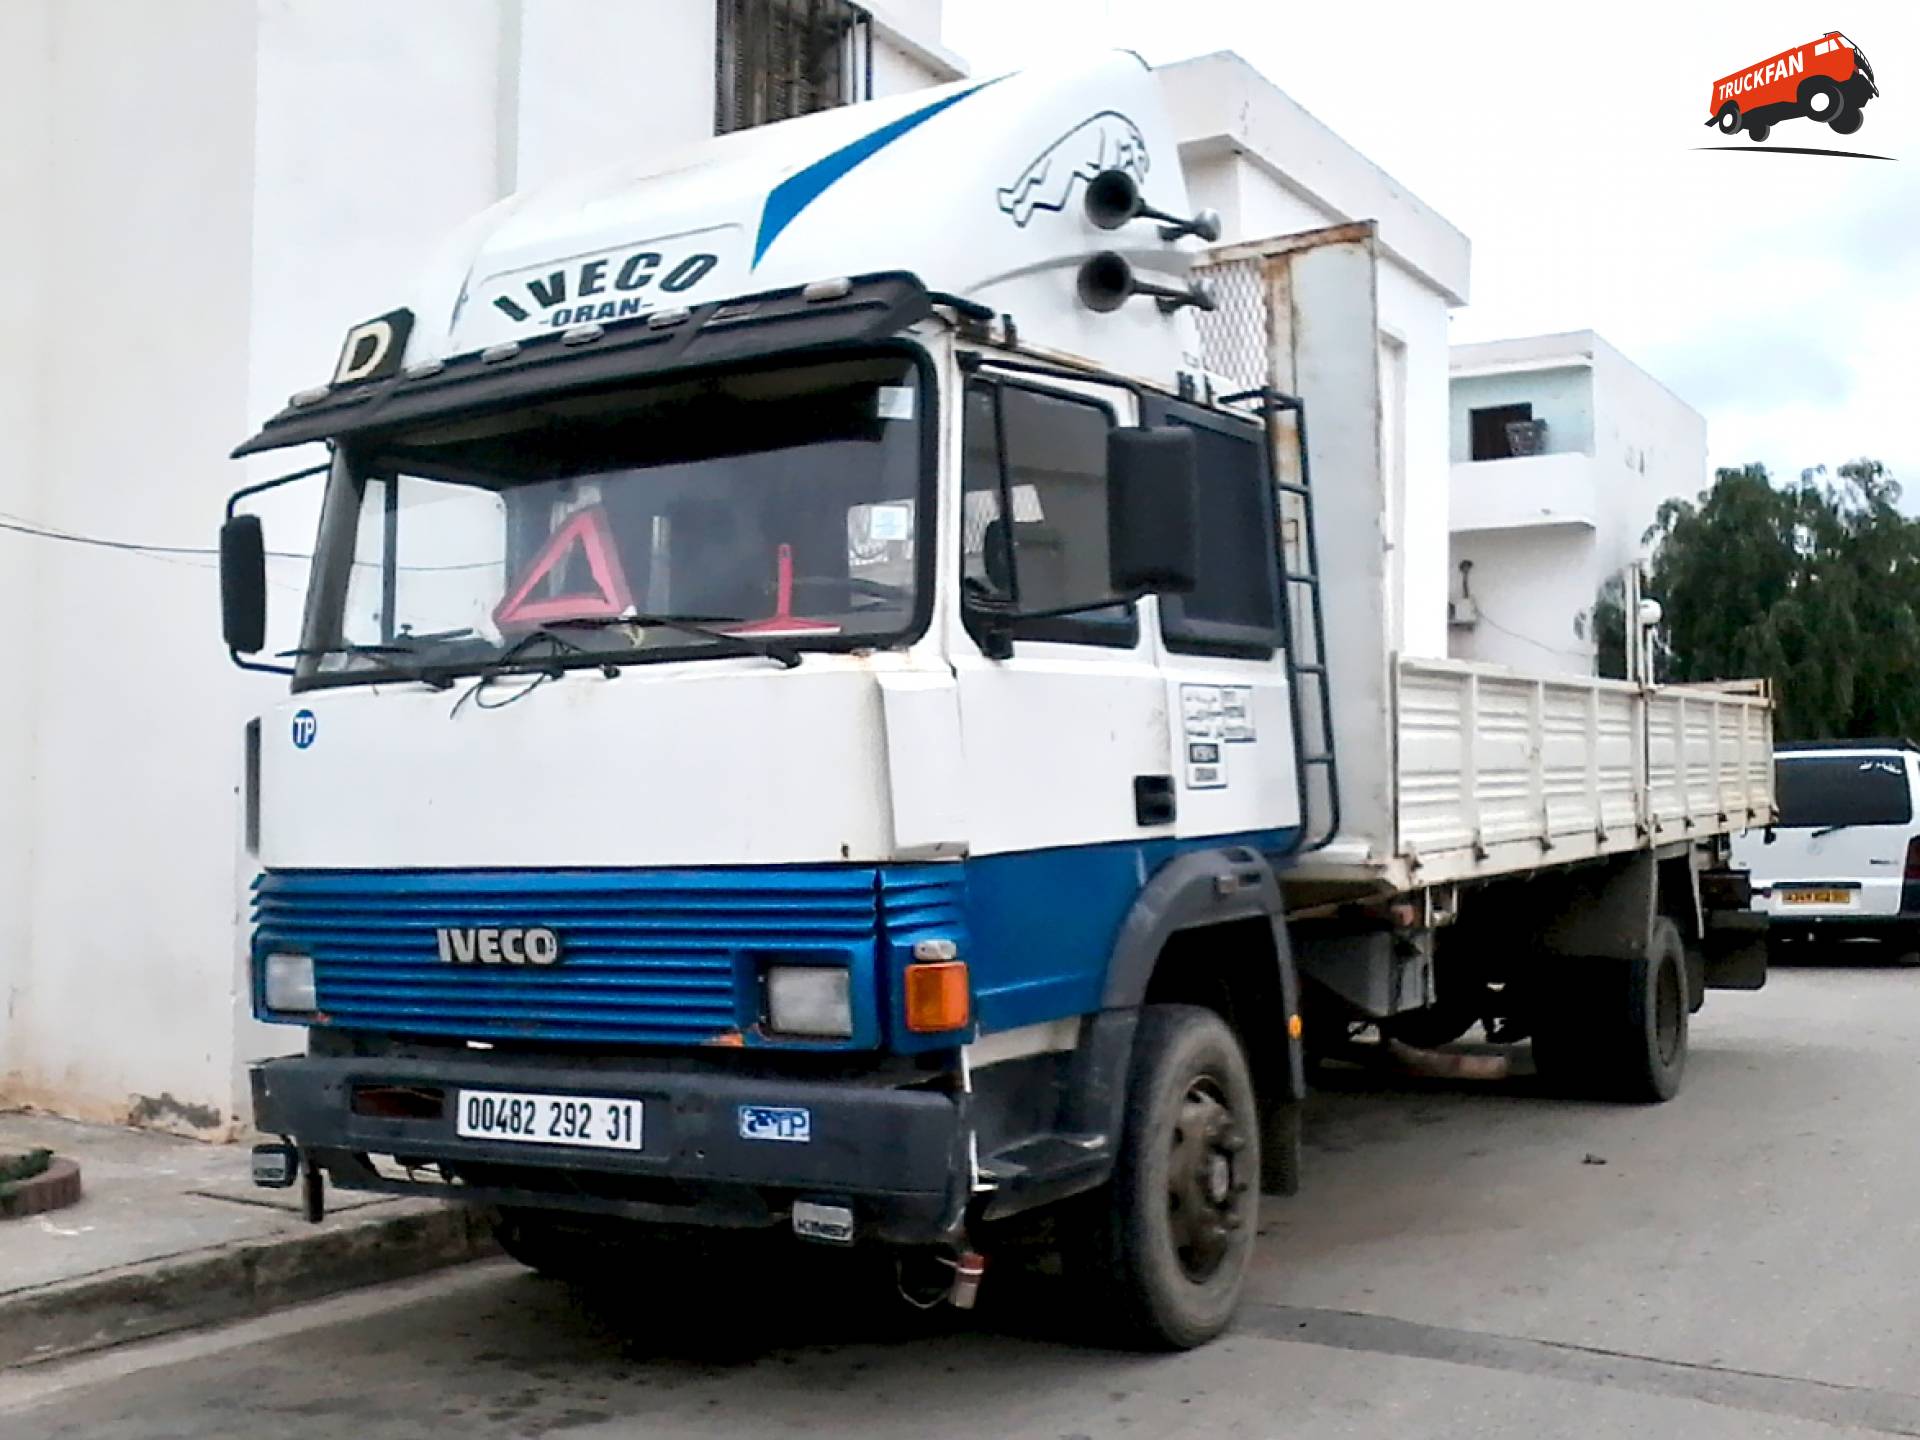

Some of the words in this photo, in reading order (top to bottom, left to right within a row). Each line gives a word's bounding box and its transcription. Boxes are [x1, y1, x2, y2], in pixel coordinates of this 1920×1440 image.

[493, 251, 718, 322] IVECO
[335, 320, 392, 384] D
[436, 927, 558, 965] IVECO
[467, 1096, 536, 1136] 00482
[548, 1102, 592, 1140] 292
[606, 1104, 633, 1143] 31
